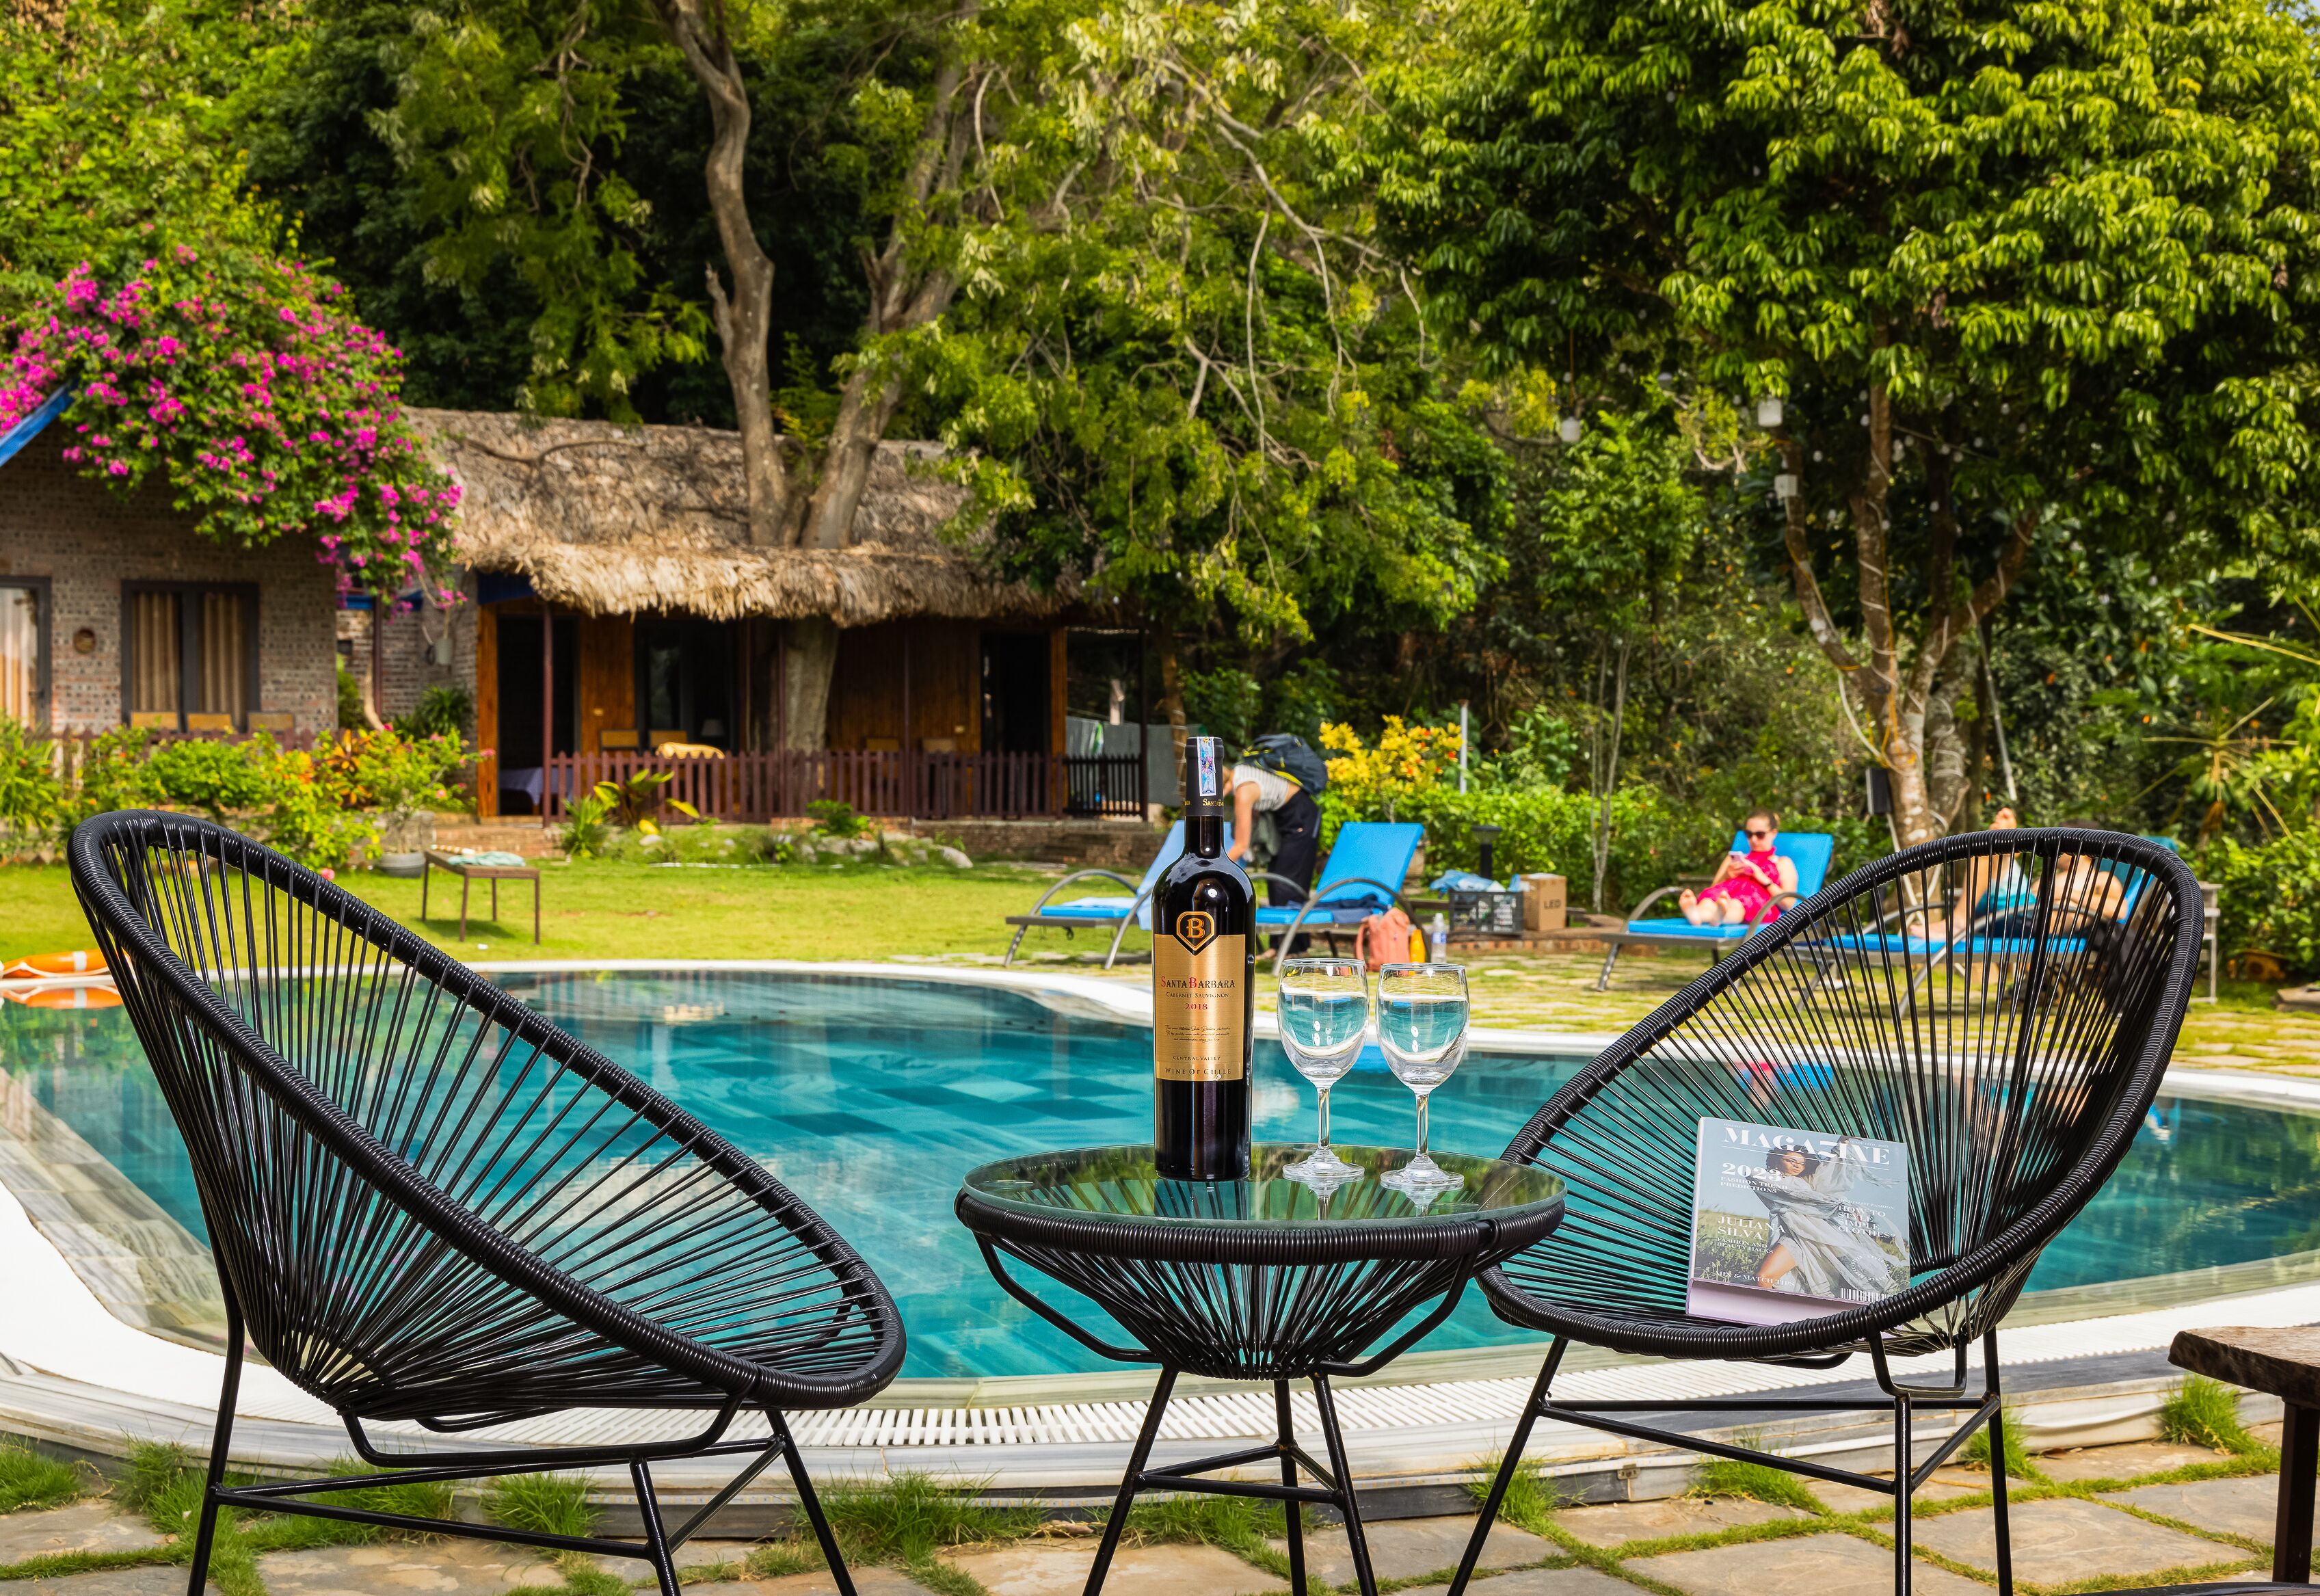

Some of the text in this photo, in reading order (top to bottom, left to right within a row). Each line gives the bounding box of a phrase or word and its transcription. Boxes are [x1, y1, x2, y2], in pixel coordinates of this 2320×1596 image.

[1543, 900, 1562, 909] LED
[1186, 918, 1205, 938] B
[1721, 1127, 1890, 1165] MAGAZINE
[1721, 1162, 1782, 1182] 2023
[1720, 1176, 1788, 1190] FASHION TREND
[1720, 1181, 1777, 1193] PREDICTIONS
[1838, 1212, 1874, 1223] STYLE
[1839, 1205, 1886, 1218] HOW TO
[1718, 1216, 1786, 1233] JULIANA
[1838, 1219, 1880, 1230] SIMPLE
[1717, 1226, 1763, 1240] SILVA
[1838, 1225, 1895, 1239] CLOTHES?
[1716, 1242, 1747, 1250] BEAUTY
[1717, 1237, 1750, 1246] FASHION
[1743, 1275, 1774, 1284] MATCH
